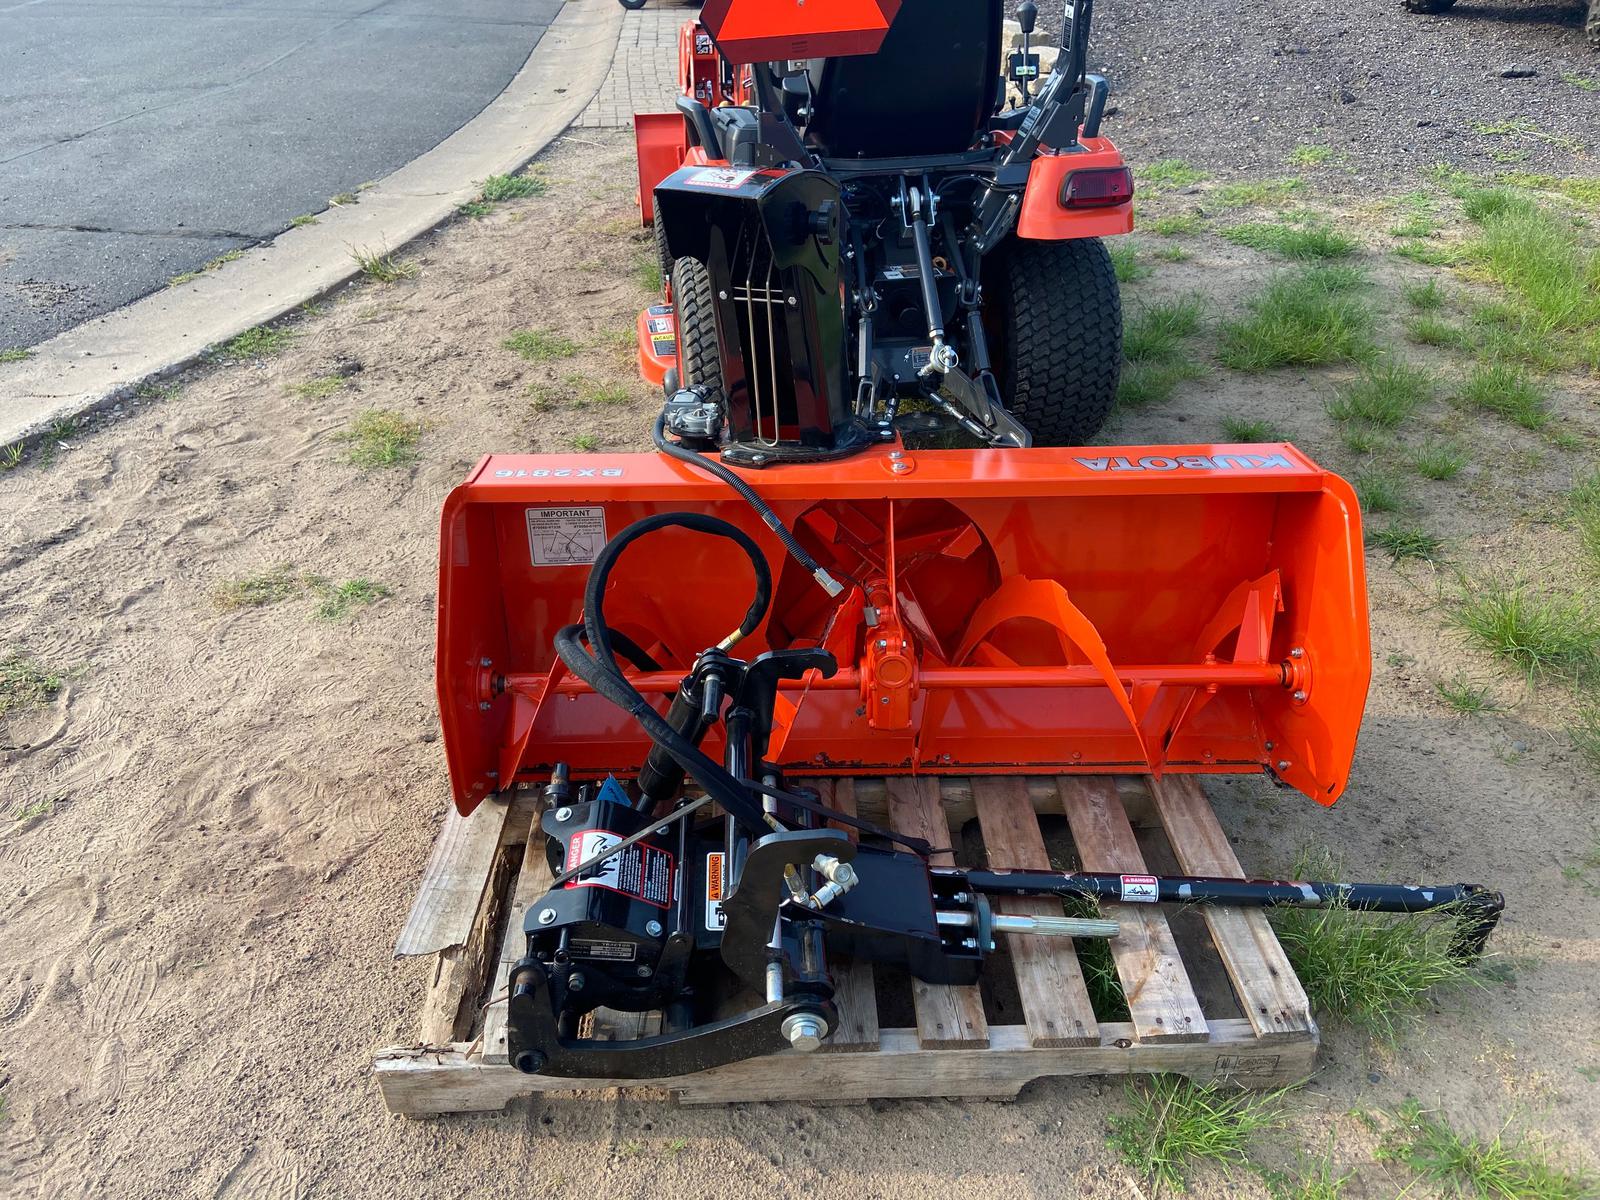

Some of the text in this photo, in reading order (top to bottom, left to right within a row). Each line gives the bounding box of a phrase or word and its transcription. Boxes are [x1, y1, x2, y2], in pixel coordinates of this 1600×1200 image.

[1072, 454, 1295, 472] KUBOTA
[495, 468, 623, 477] BX2816
[540, 509, 591, 518] IMPORTANT
[568, 837, 580, 870] ANGER
[711, 856, 720, 891] WARNING
